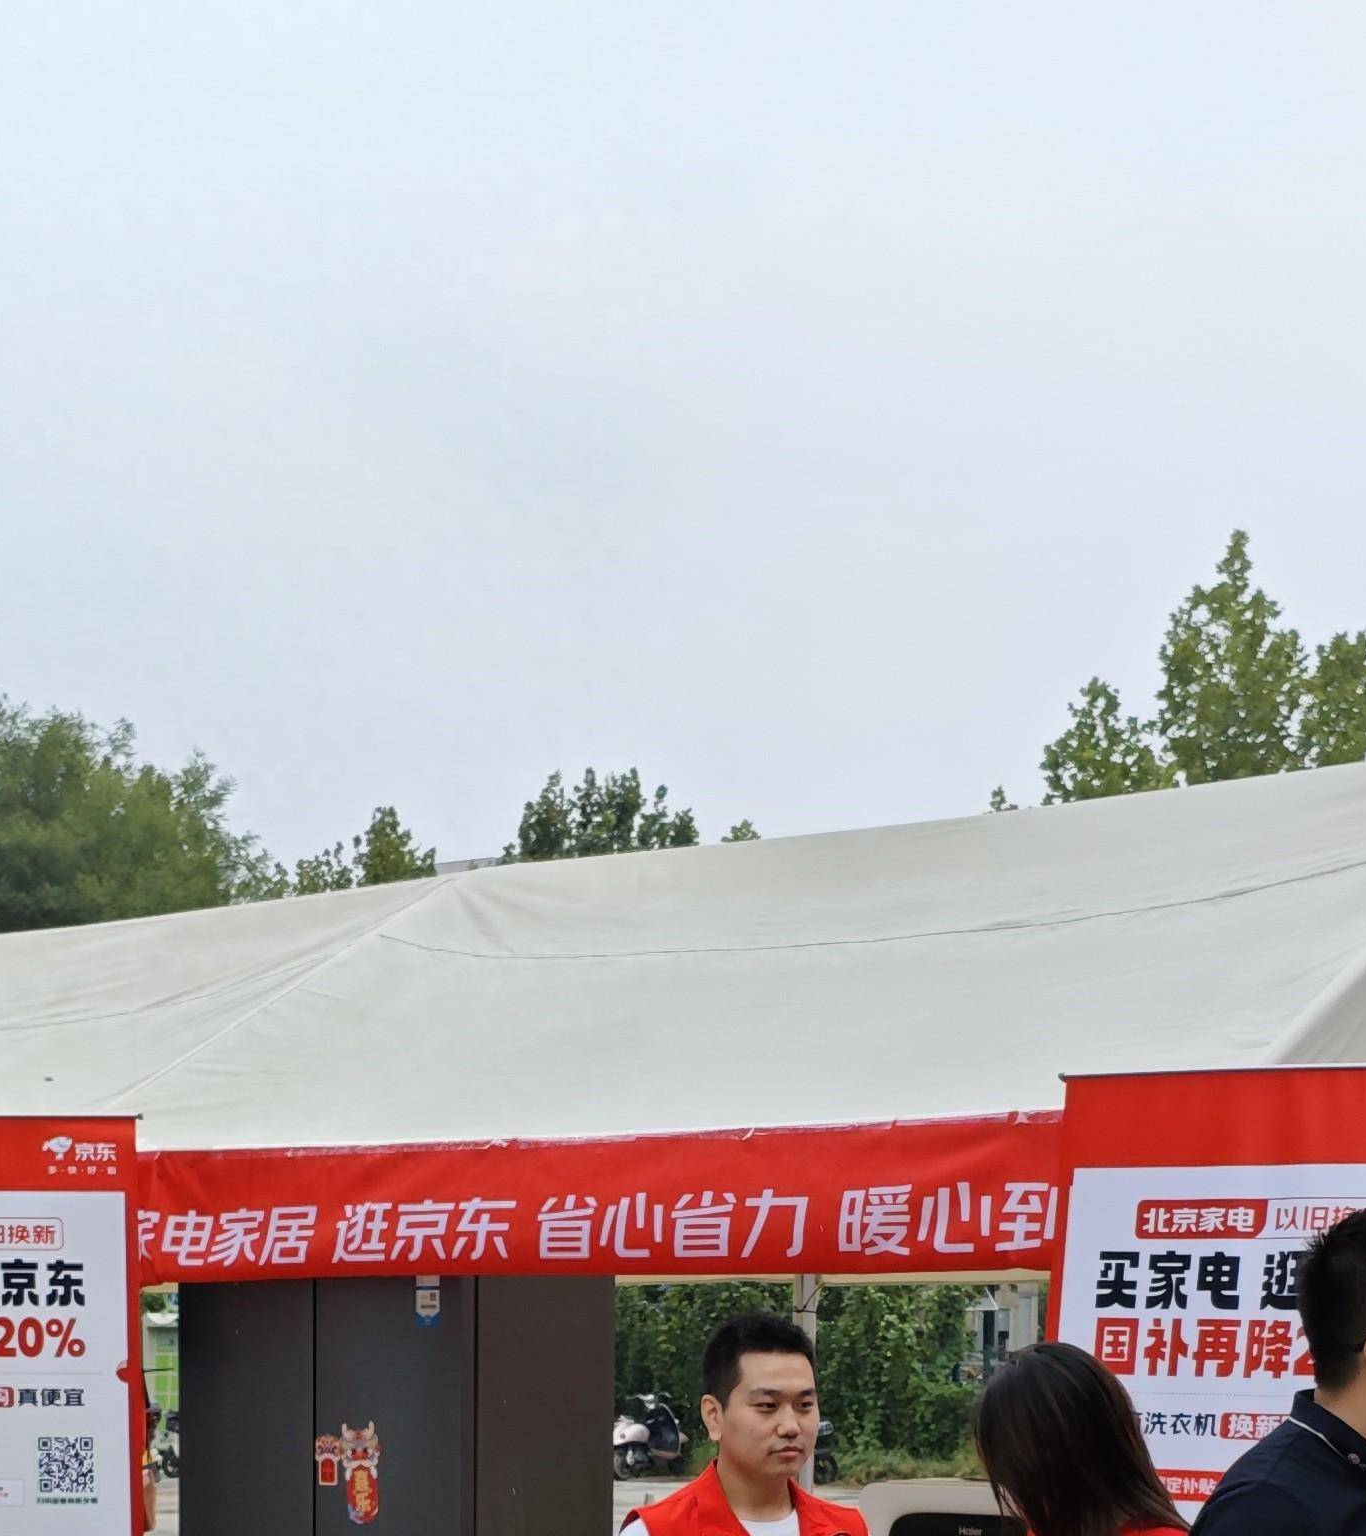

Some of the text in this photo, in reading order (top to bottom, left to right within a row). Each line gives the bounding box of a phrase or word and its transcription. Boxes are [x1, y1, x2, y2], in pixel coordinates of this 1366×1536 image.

[74, 1142, 117, 1162] 京东
[332, 1197, 517, 1264] 逛京东
[537, 1188, 810, 1259] 省心省力
[838, 1181, 1059, 1257] 暖心到
[1142, 1207, 1256, 1234] 北京家电
[1095, 1250, 1241, 1311] 买家电
[17, 1387, 85, 1407] 真便宜
[1228, 1414, 1288, 1438] 换新
